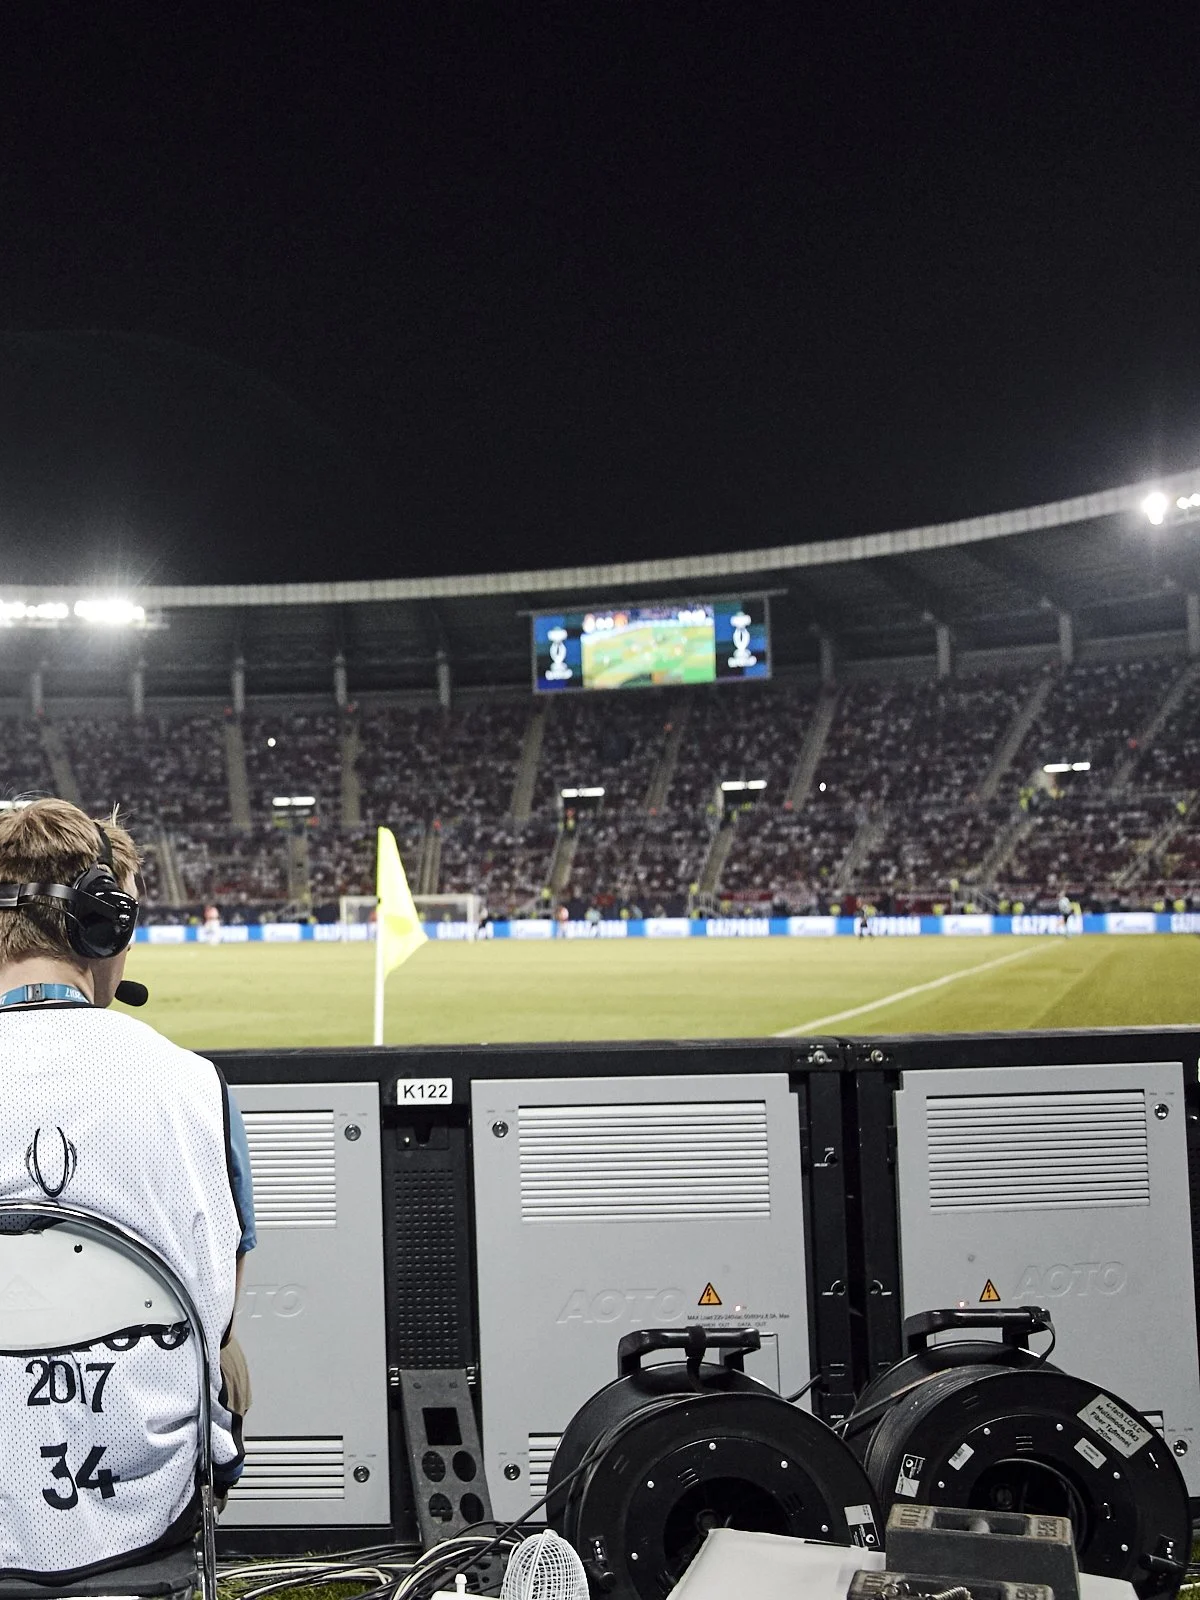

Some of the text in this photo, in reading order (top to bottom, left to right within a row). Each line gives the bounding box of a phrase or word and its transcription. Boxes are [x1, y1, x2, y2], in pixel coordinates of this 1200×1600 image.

[403, 1084, 448, 1099] K122
[1012, 1261, 1128, 1300] AOTO
[556, 1286, 686, 1324] AOTO
[25, 1359, 117, 1414] 2017
[40, 1442, 121, 1510] 34
